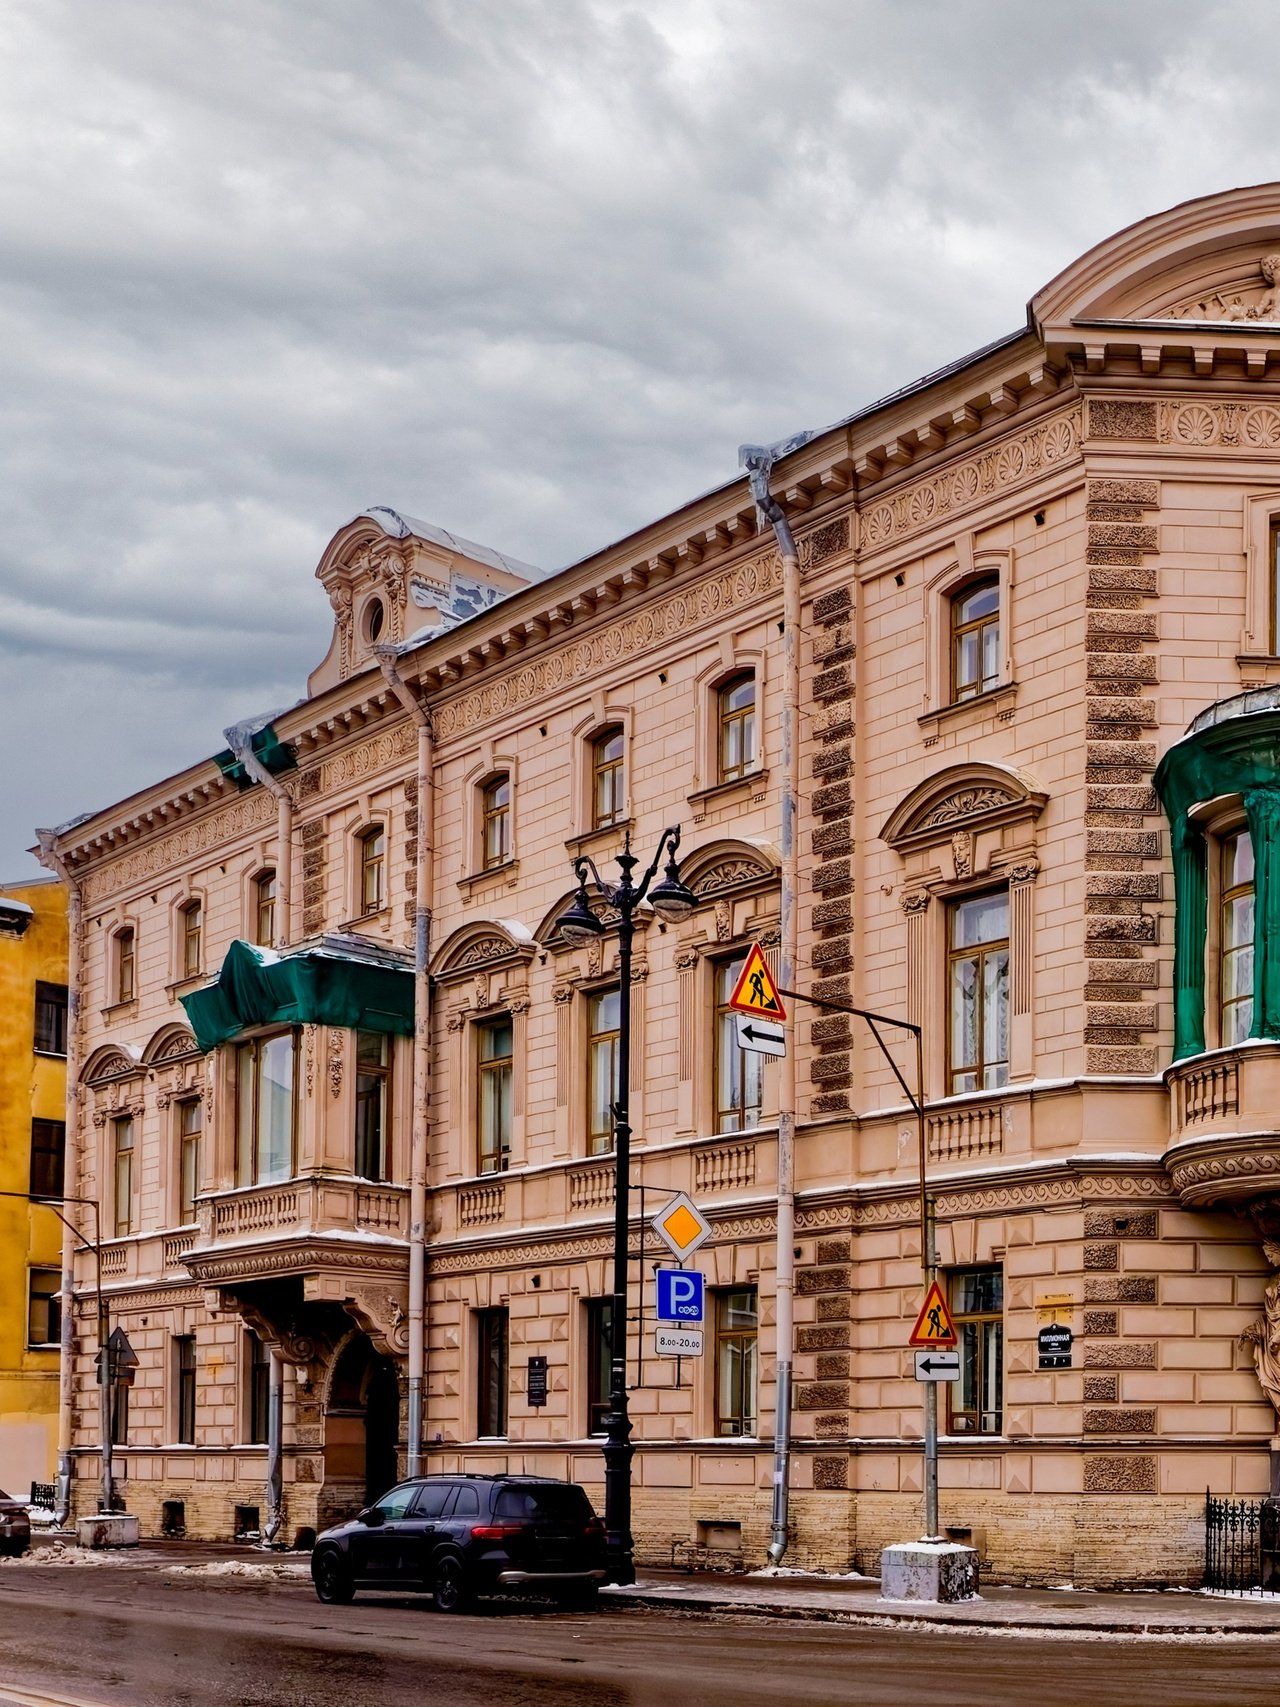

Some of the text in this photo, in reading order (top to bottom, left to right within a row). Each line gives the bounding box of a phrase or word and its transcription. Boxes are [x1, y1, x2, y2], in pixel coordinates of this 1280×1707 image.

[670, 1275, 695, 1315] P
[660, 1337, 700, 1348] 8.00-20.00
[1053, 1356, 1057, 1366] 7
